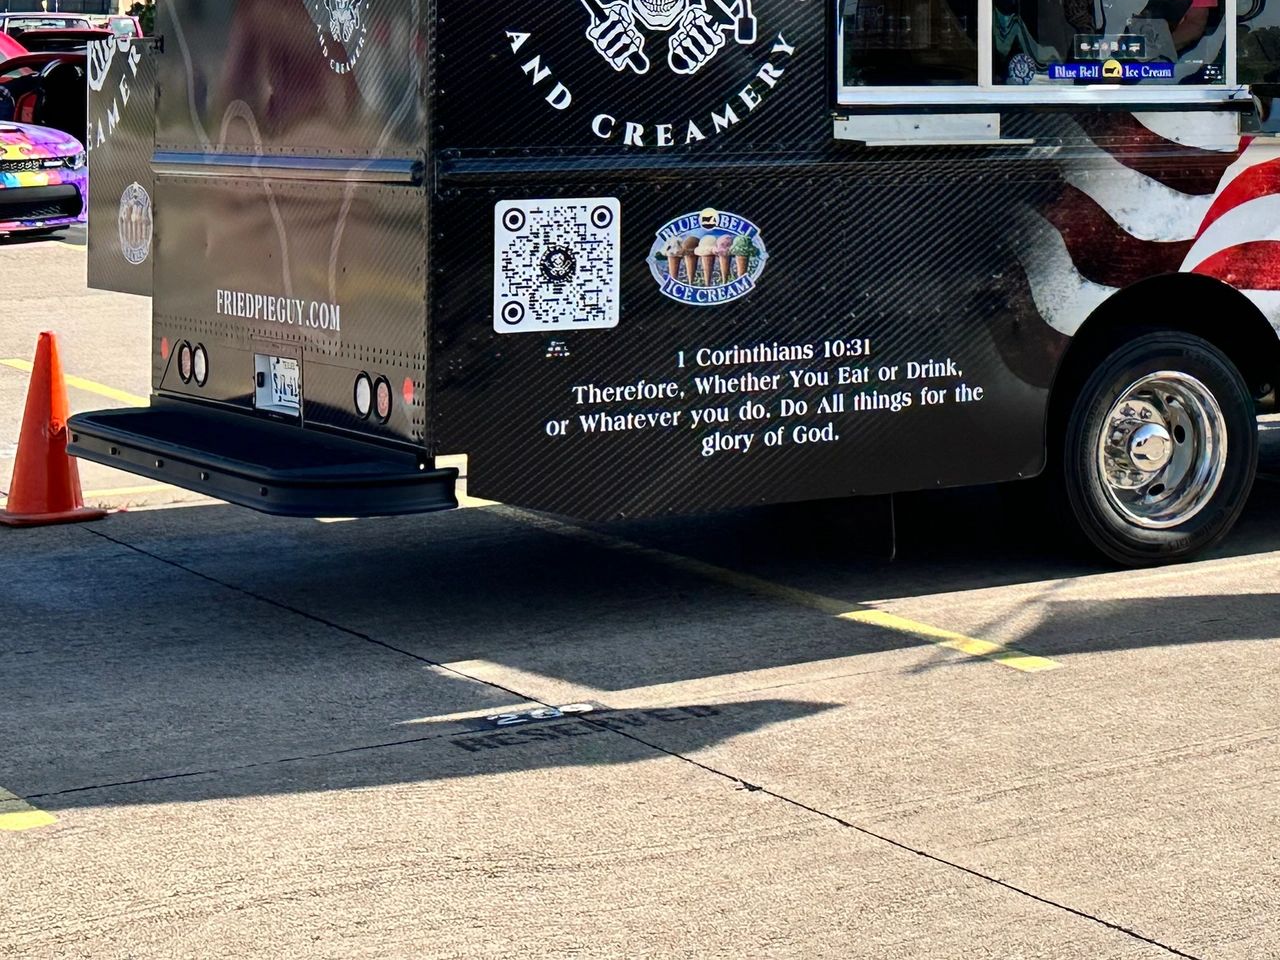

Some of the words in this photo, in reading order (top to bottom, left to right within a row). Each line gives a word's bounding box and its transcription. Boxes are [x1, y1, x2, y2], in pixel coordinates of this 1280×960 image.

[506, 29, 572, 111] AND
[592, 34, 796, 147] CREAMERY
[1054, 65, 1077, 78] Blue
[1079, 65, 1099, 78] Bell
[1125, 65, 1139, 78] Ice
[1141, 65, 1172, 78] Cream
[661, 216, 699, 239] BLUE
[720, 215, 753, 236] BELL
[666, 280, 694, 300] ICE
[696, 278, 750, 302] CREAM
[216, 289, 340, 331] FRIEDPIEGUY.COM
[678, 351, 685, 368] 1
[696, 342, 814, 367] Corinthians
[824, 339, 870, 358] 10:31
[572, 380, 685, 404] Therefore,
[695, 373, 781, 394] Whether
[790, 369, 828, 388] You
[838, 366, 869, 385] Eat
[878, 365, 899, 381] or
[907, 358, 963, 379] Drink,
[545, 419, 569, 436] or
[579, 410, 682, 433] Whatever
[690, 407, 729, 428] you
[739, 401, 771, 421] do.
[780, 399, 808, 417] Do
[817, 393, 844, 414] All
[854, 391, 912, 412] things
[921, 386, 947, 405] for
[955, 383, 984, 403] the
[701, 431, 754, 456] glory
[764, 427, 785, 446] of
[792, 422, 839, 444] God.
